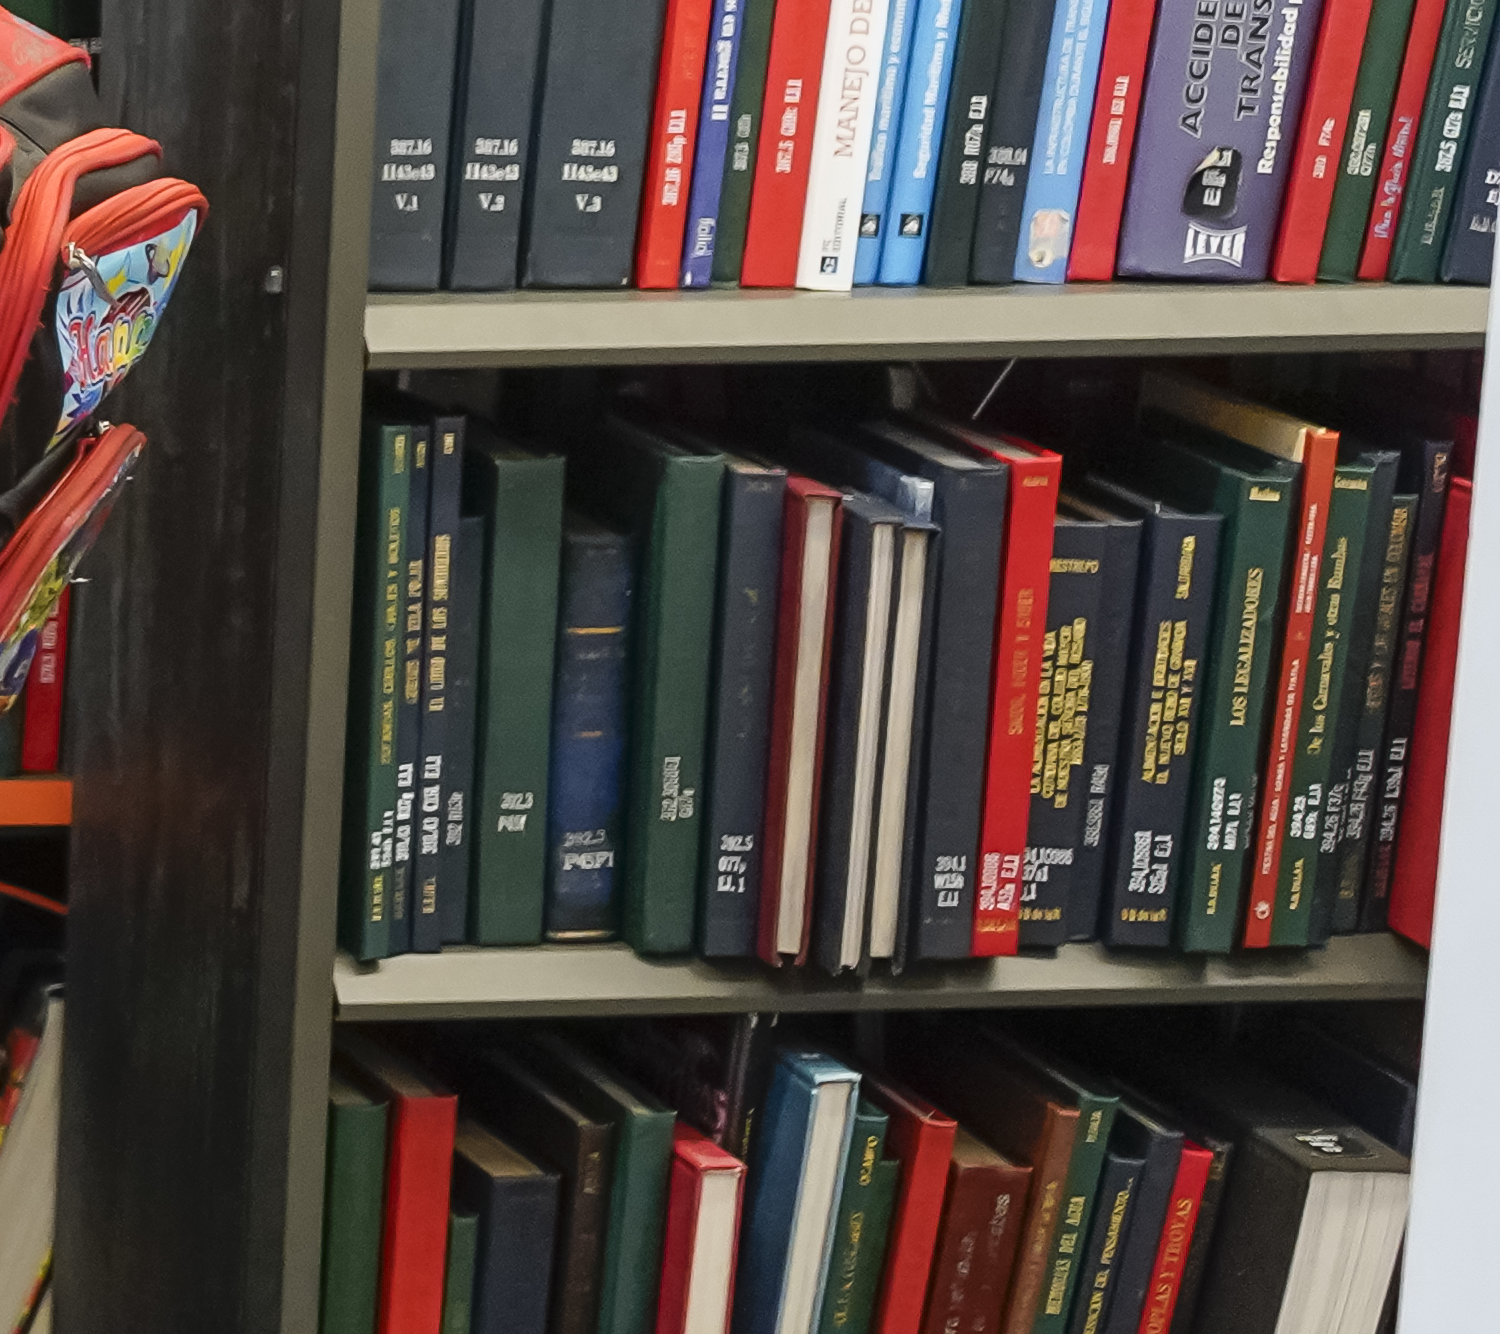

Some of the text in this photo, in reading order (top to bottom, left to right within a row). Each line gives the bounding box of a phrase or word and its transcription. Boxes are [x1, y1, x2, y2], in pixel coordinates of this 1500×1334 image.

[848, 0, 875, 36] DE
[1219, 1, 1246, 48] DE
[832, 45, 870, 158] MANEJO
[1256, 7, 1300, 174] Responsabilidad
[913, 108, 937, 178] Seguridad
[1183, 222, 1247, 268] LEYER
[1229, 567, 1263, 726] LOS LEGALIZADORES
[1161, 1198, 1193, 1265] TROVAS
